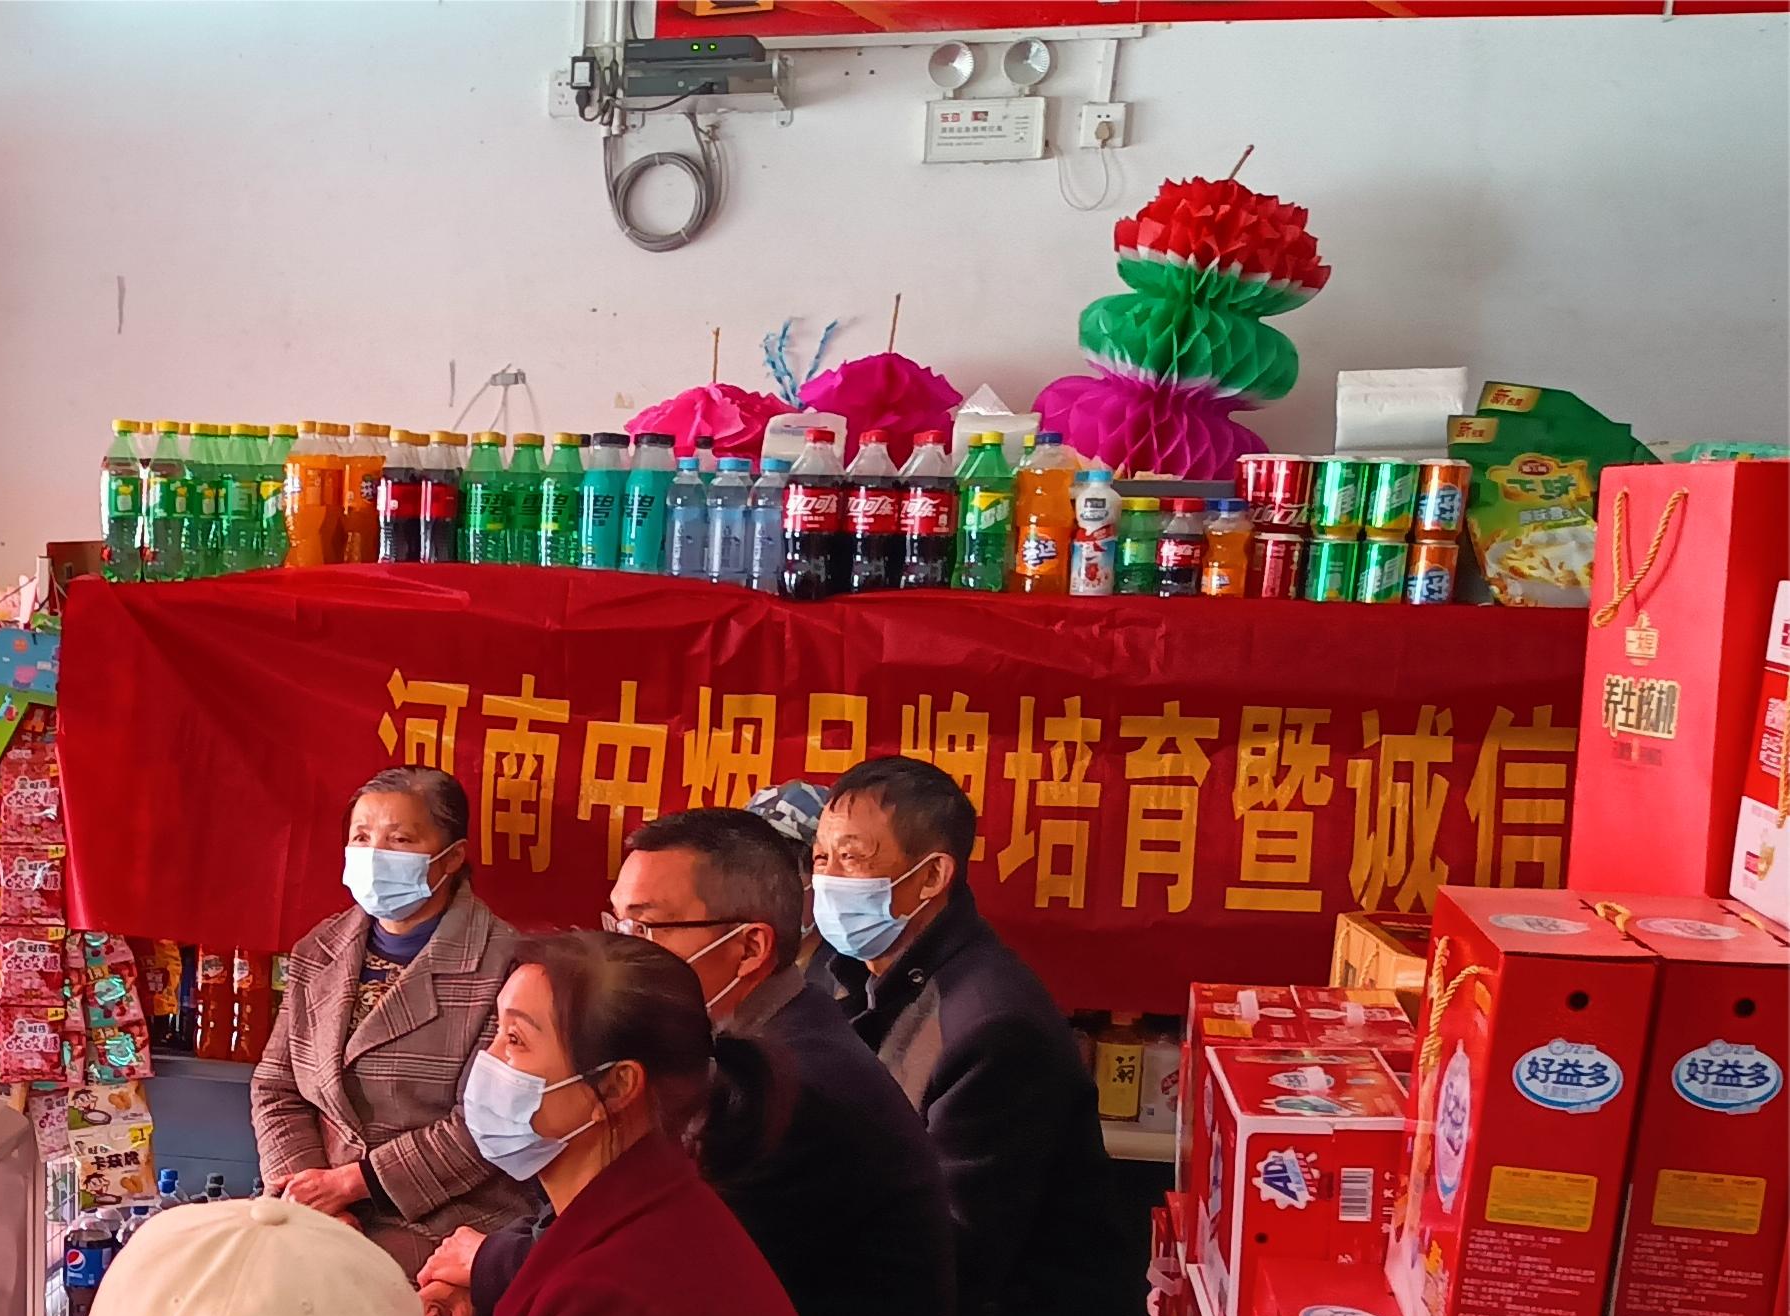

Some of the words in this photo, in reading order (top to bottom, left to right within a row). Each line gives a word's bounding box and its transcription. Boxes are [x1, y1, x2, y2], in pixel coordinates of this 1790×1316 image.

[1525, 1056, 1611, 1088] 好益多
[1684, 1057, 1771, 1088] 好益多
